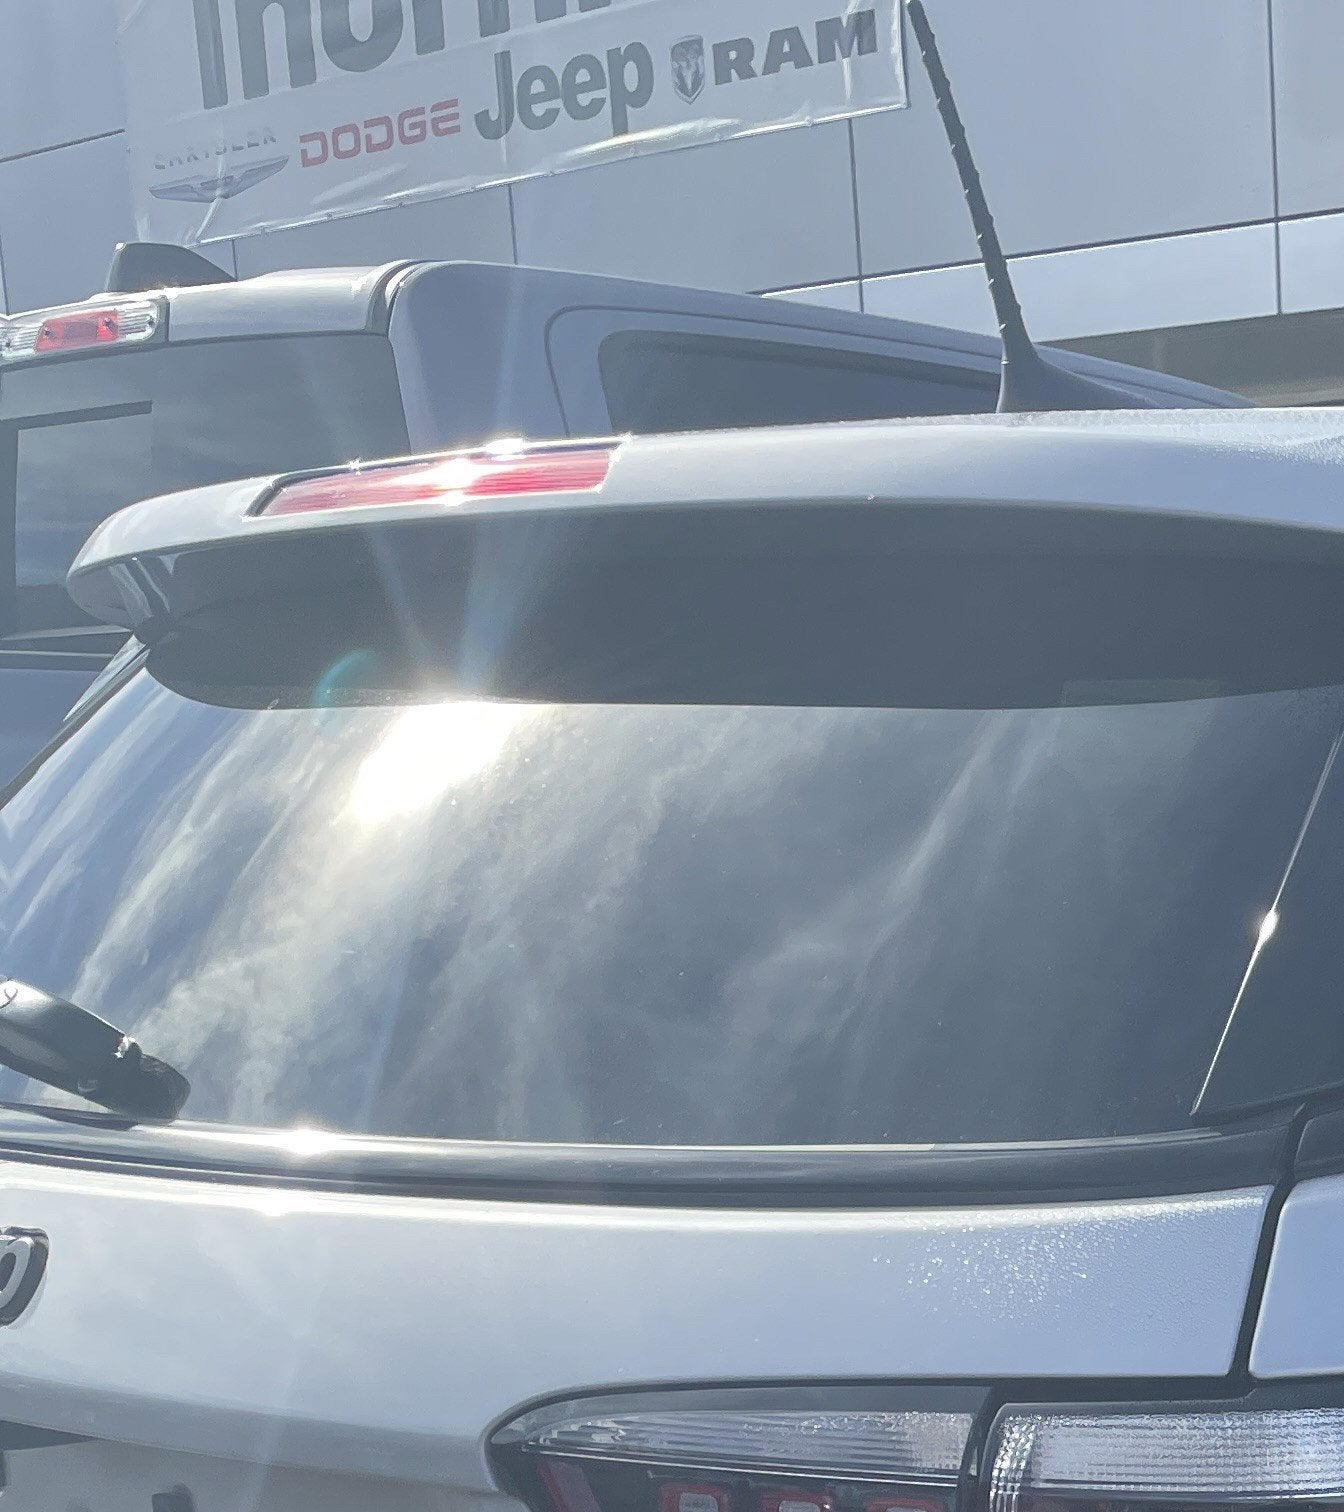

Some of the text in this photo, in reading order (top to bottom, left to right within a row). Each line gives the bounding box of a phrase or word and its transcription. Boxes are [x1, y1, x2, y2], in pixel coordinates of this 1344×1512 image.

[300, 98, 460, 168] DODGE
[474, 42, 654, 137] Jeep
[712, 9, 877, 86] RAM
